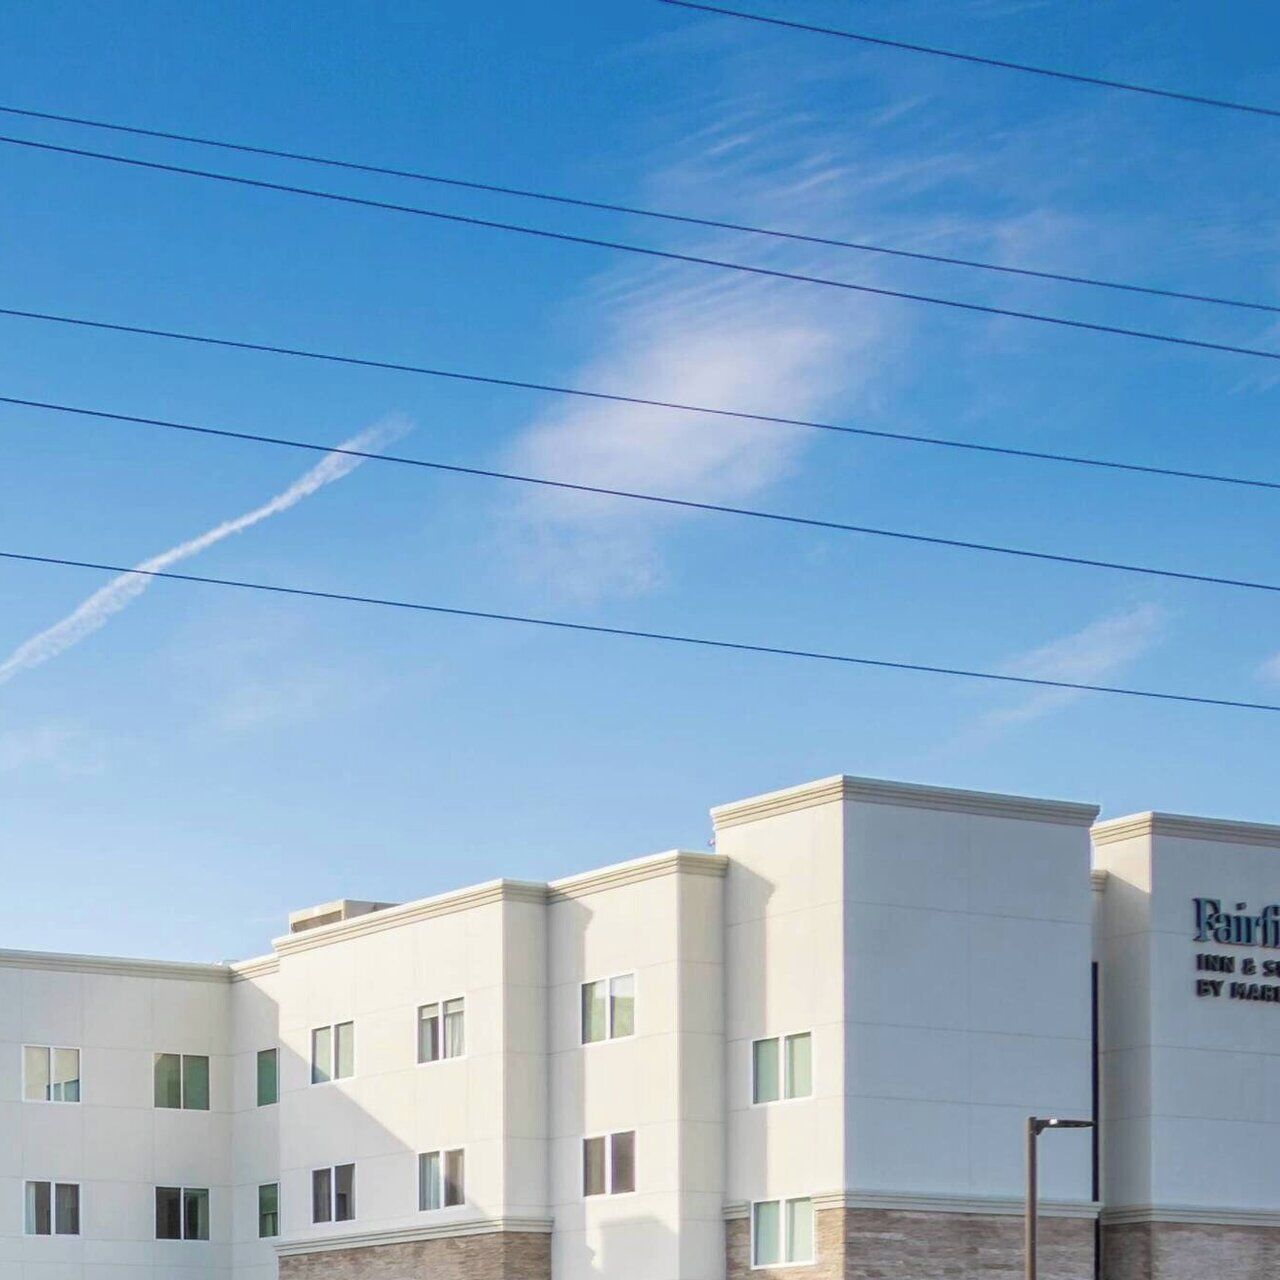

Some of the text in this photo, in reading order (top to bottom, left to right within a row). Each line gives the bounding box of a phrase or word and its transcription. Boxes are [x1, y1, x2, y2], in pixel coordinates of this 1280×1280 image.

[1196, 953, 1235, 973] INN
[1242, 958, 1256, 975] &
[1196, 979, 1224, 997] BY
